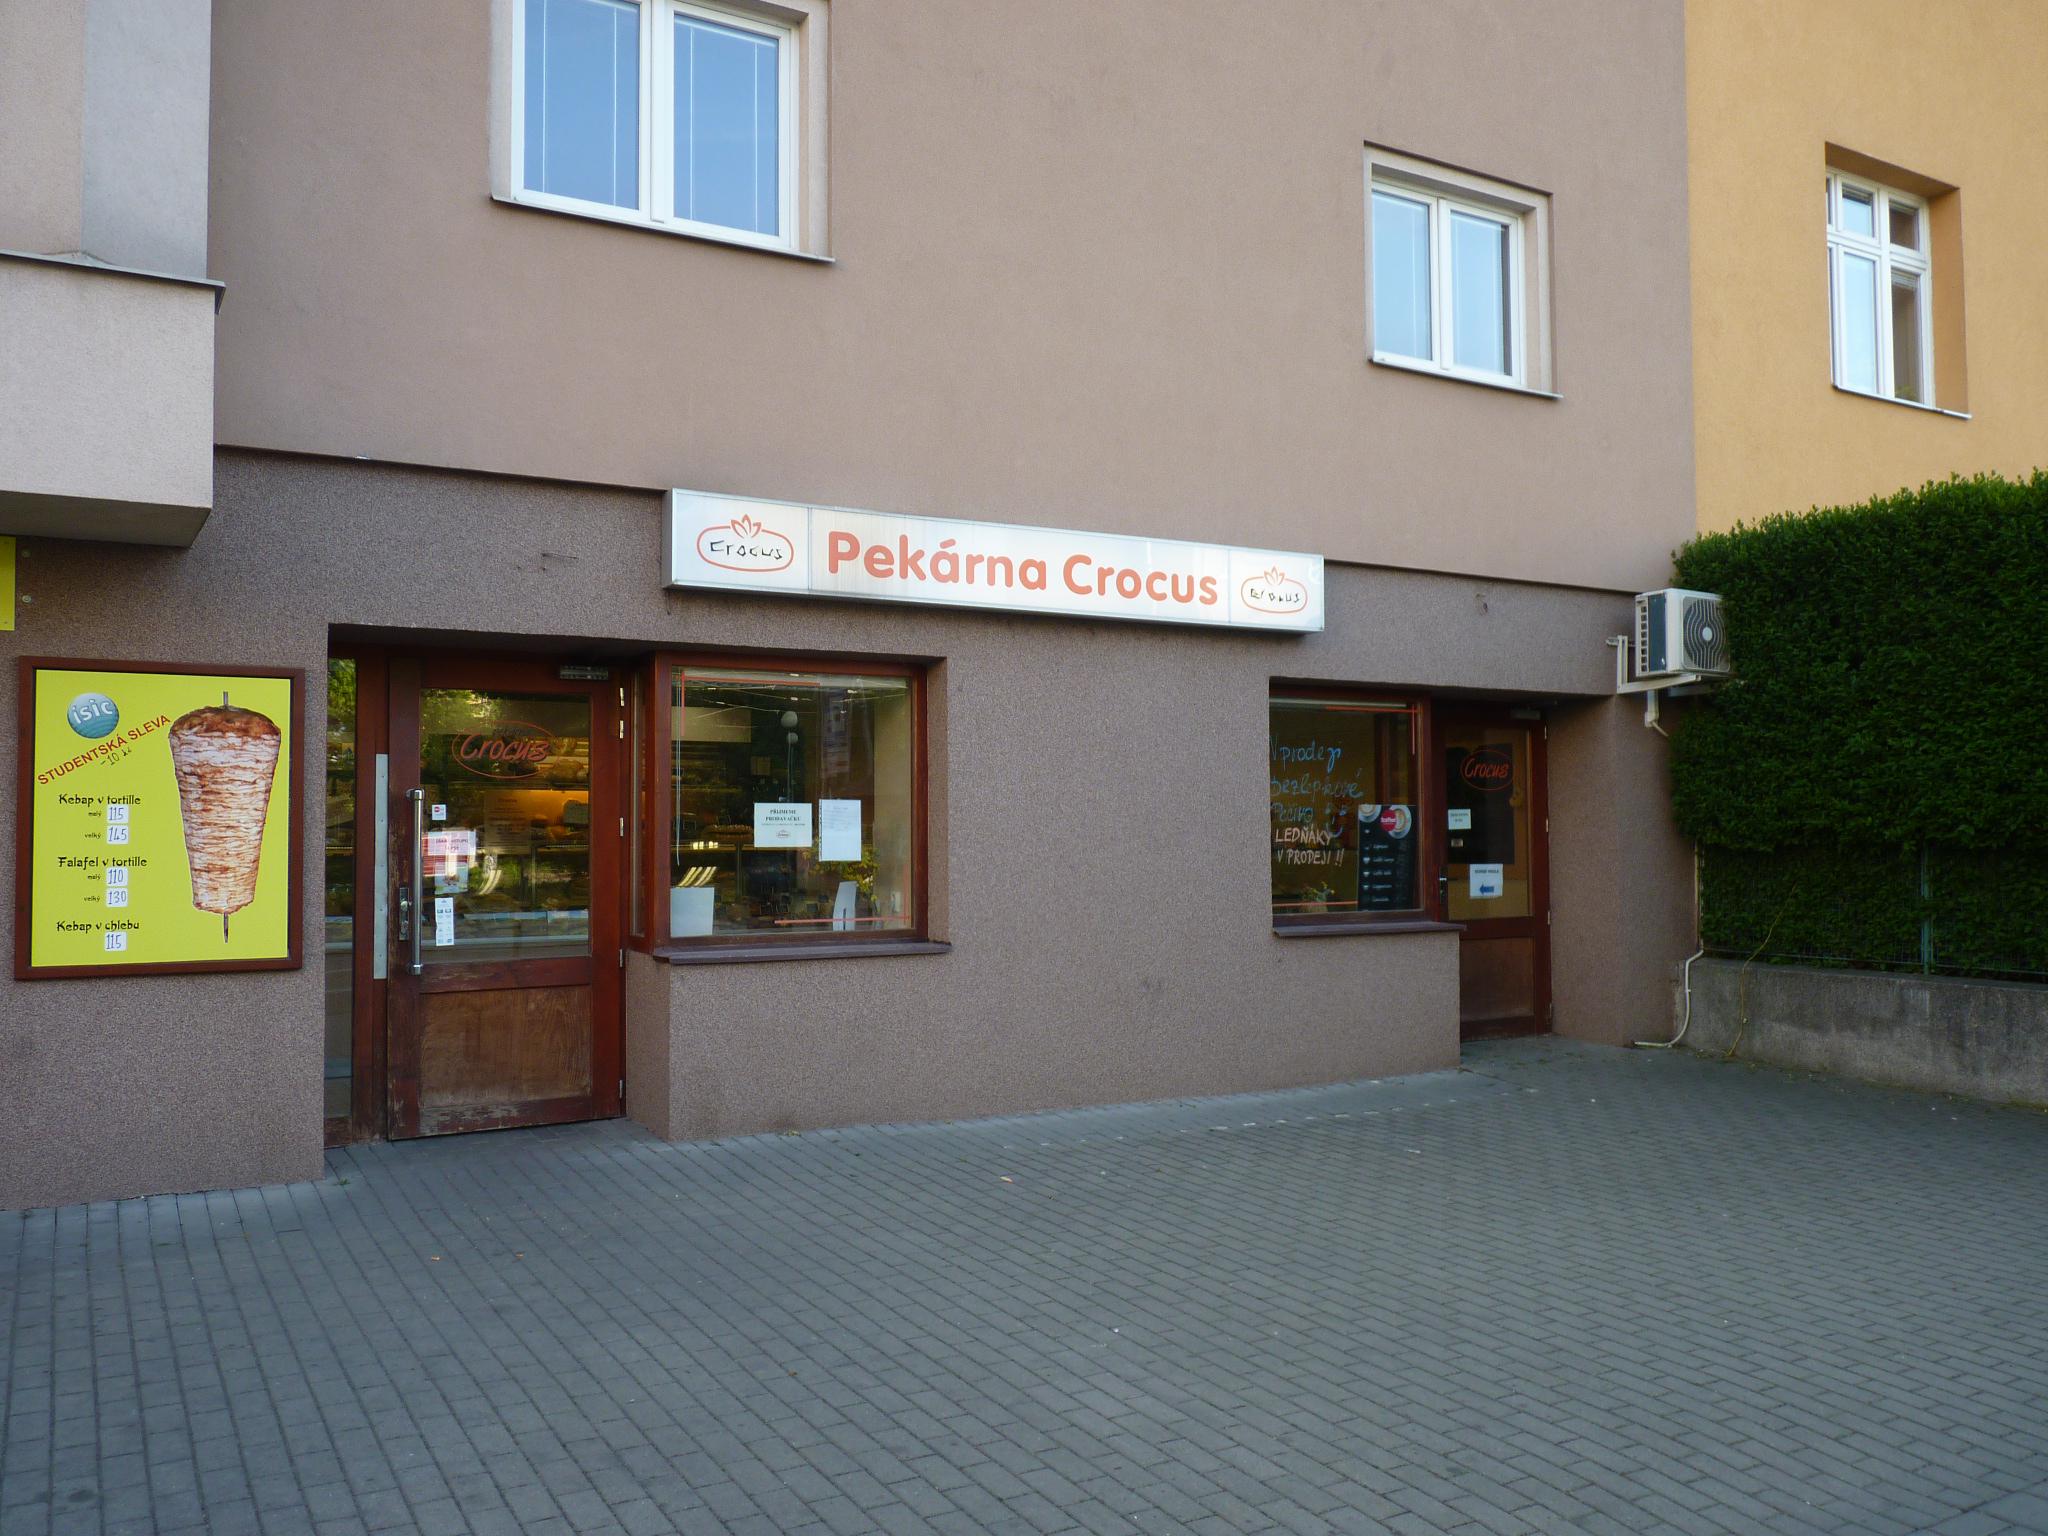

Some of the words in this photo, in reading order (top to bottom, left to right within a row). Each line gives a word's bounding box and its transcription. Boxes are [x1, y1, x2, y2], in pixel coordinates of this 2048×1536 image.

[709, 539, 783, 560] Crocus
[826, 529, 1047, 591] Pekárna
[1061, 553, 1219, 606] Crocus
[71, 697, 113, 725] isic
[37, 733, 128, 785] STUDENTSKÁ
[127, 714, 171, 741] SLEVA
[460, 733, 550, 763] Crocus
[1464, 757, 1510, 779] Crocus
[58, 793, 94, 808] Kebap
[97, 795, 105, 804] v
[107, 794, 141, 805] tortille
[108, 806, 125, 821] 115
[108, 827, 128, 842] 145
[1274, 823, 1332, 846] LEDŇÁKY
[58, 856, 99, 870] Falafel
[102, 858, 109, 867] v
[112, 856, 148, 867] tortille
[1276, 848, 1284, 863] V
[1286, 848, 1331, 866] PRODEJI
[107, 868, 124, 885] 110
[107, 890, 127, 905] 130
[56, 920, 92, 934] Kebap
[95, 922, 102, 930] v
[105, 919, 140, 932] chlebu
[106, 933, 122, 950] 115
